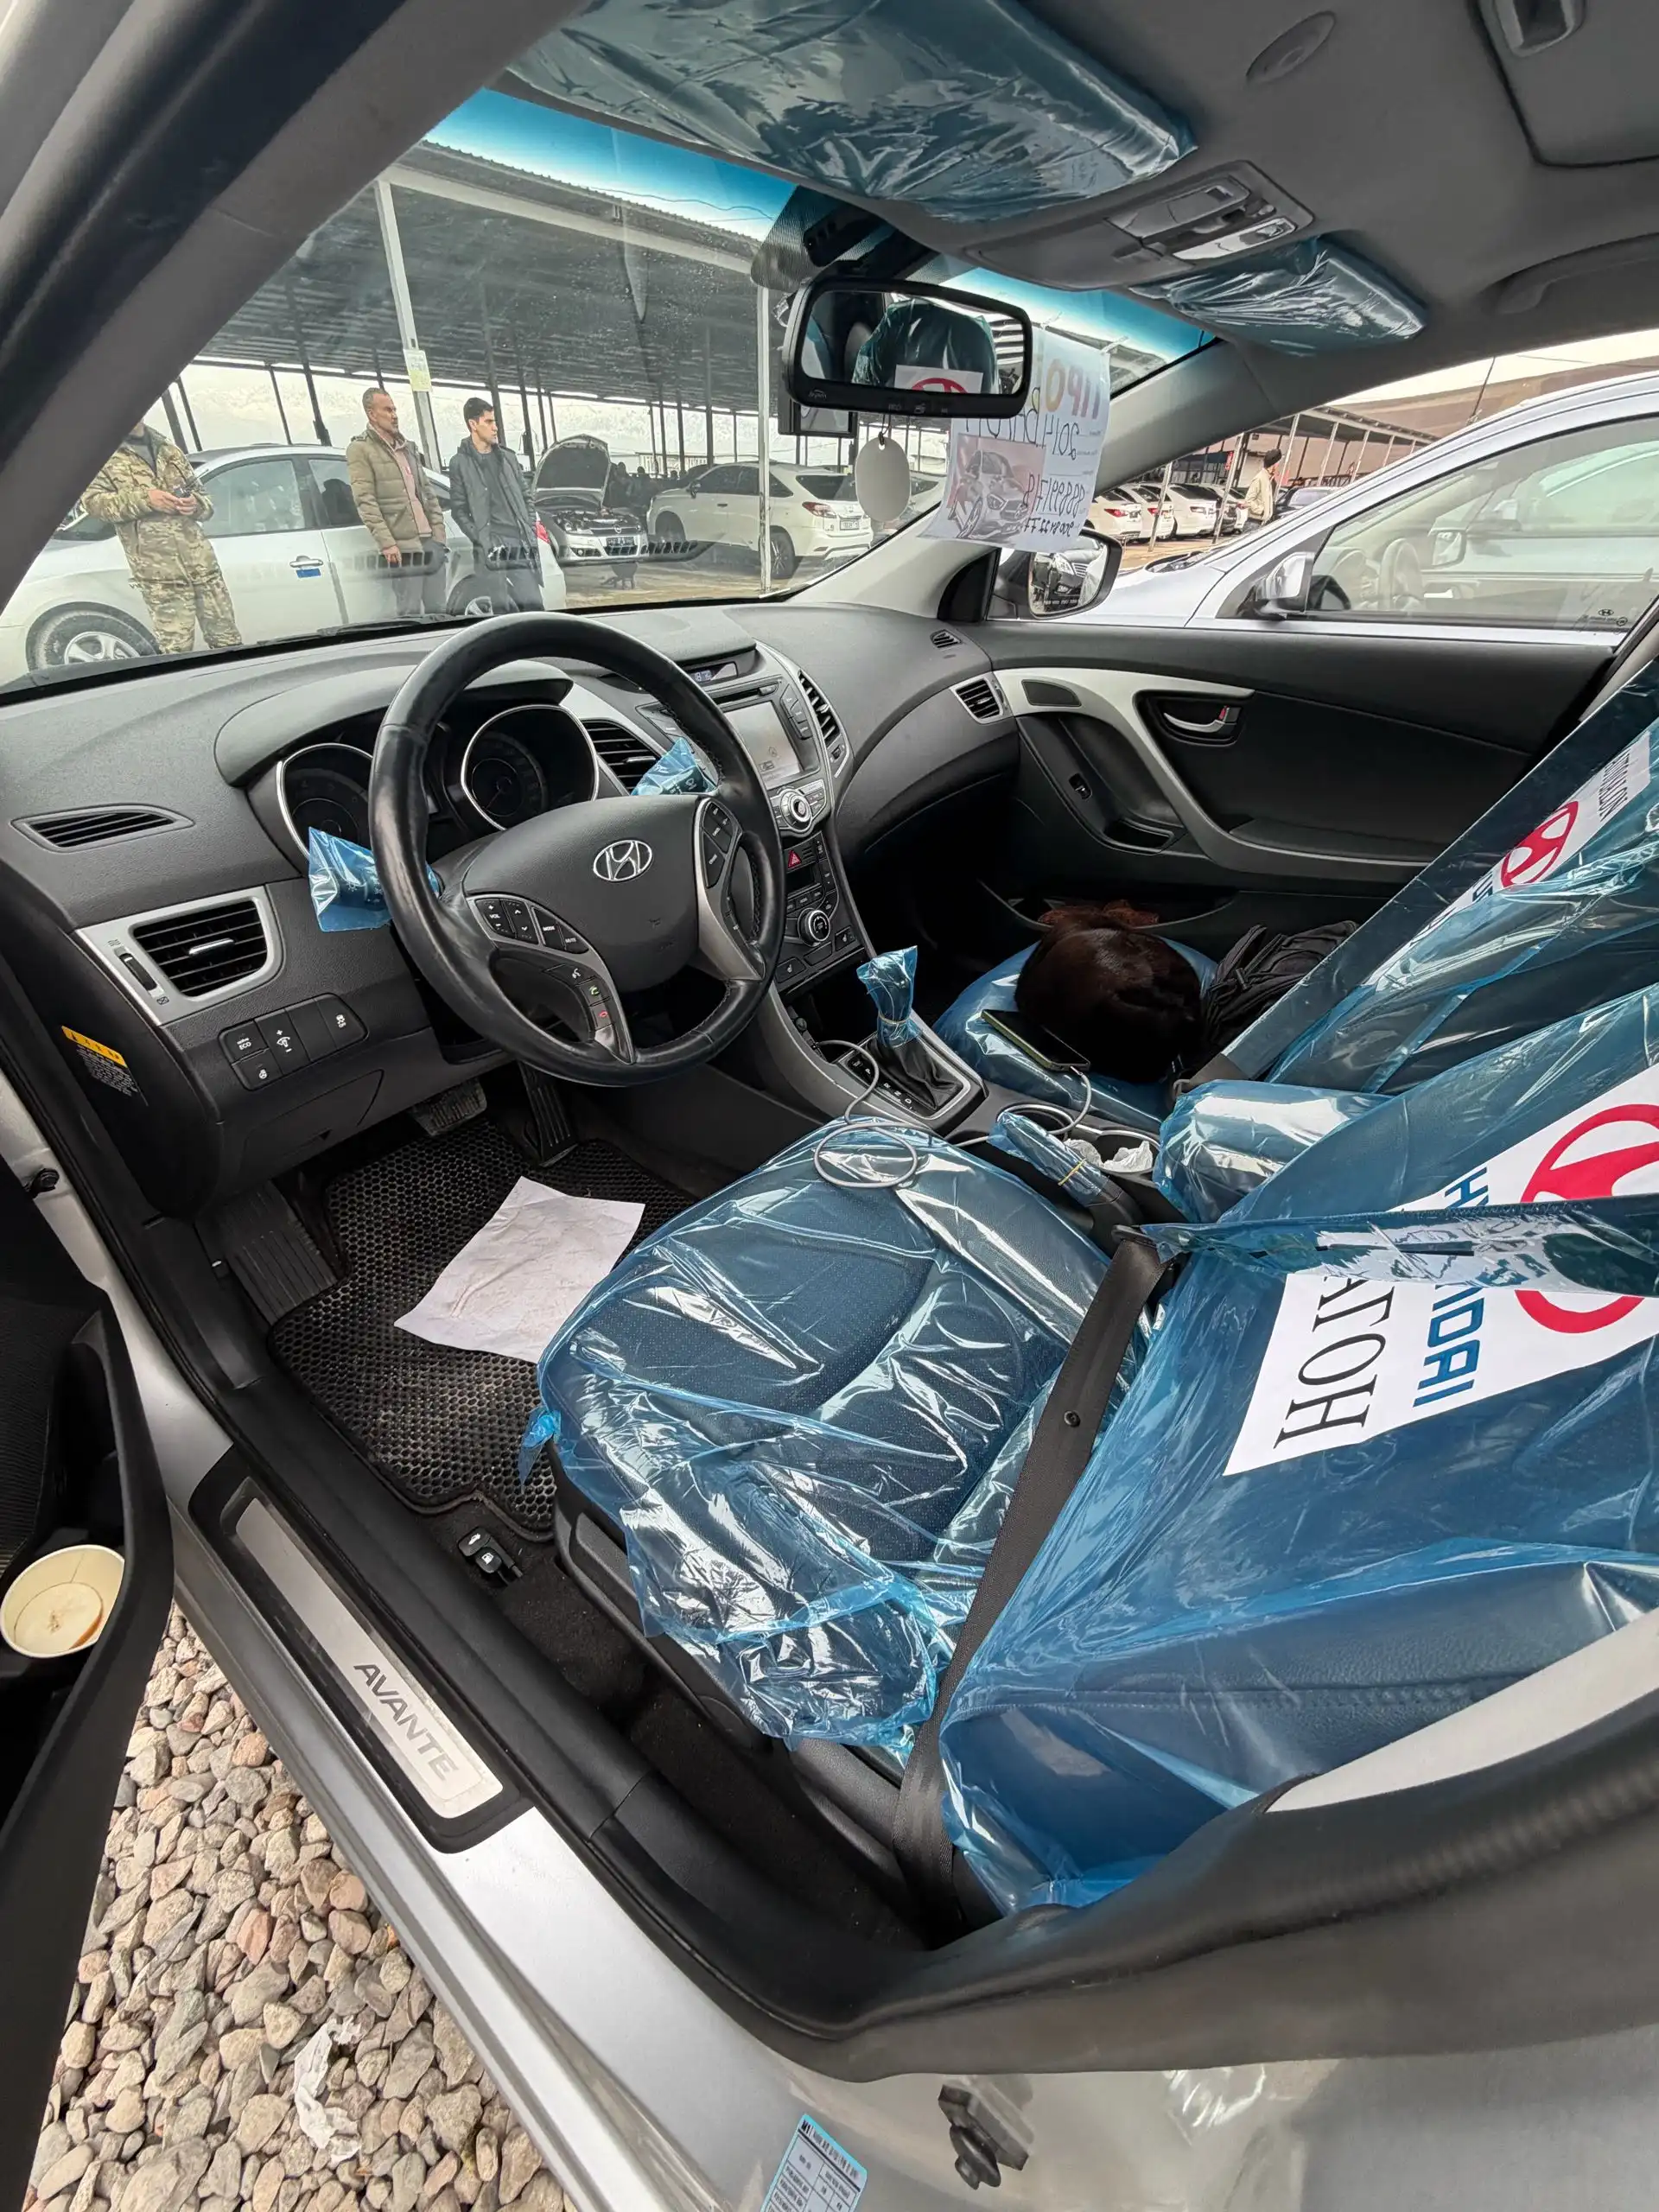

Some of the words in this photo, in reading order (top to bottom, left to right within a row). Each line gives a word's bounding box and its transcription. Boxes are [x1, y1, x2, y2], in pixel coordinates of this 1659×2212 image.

[238, 1041, 251, 1051] ECO
[1273, 1275, 1395, 1450] АГОН
[353, 1663, 460, 1782] AVANTE
